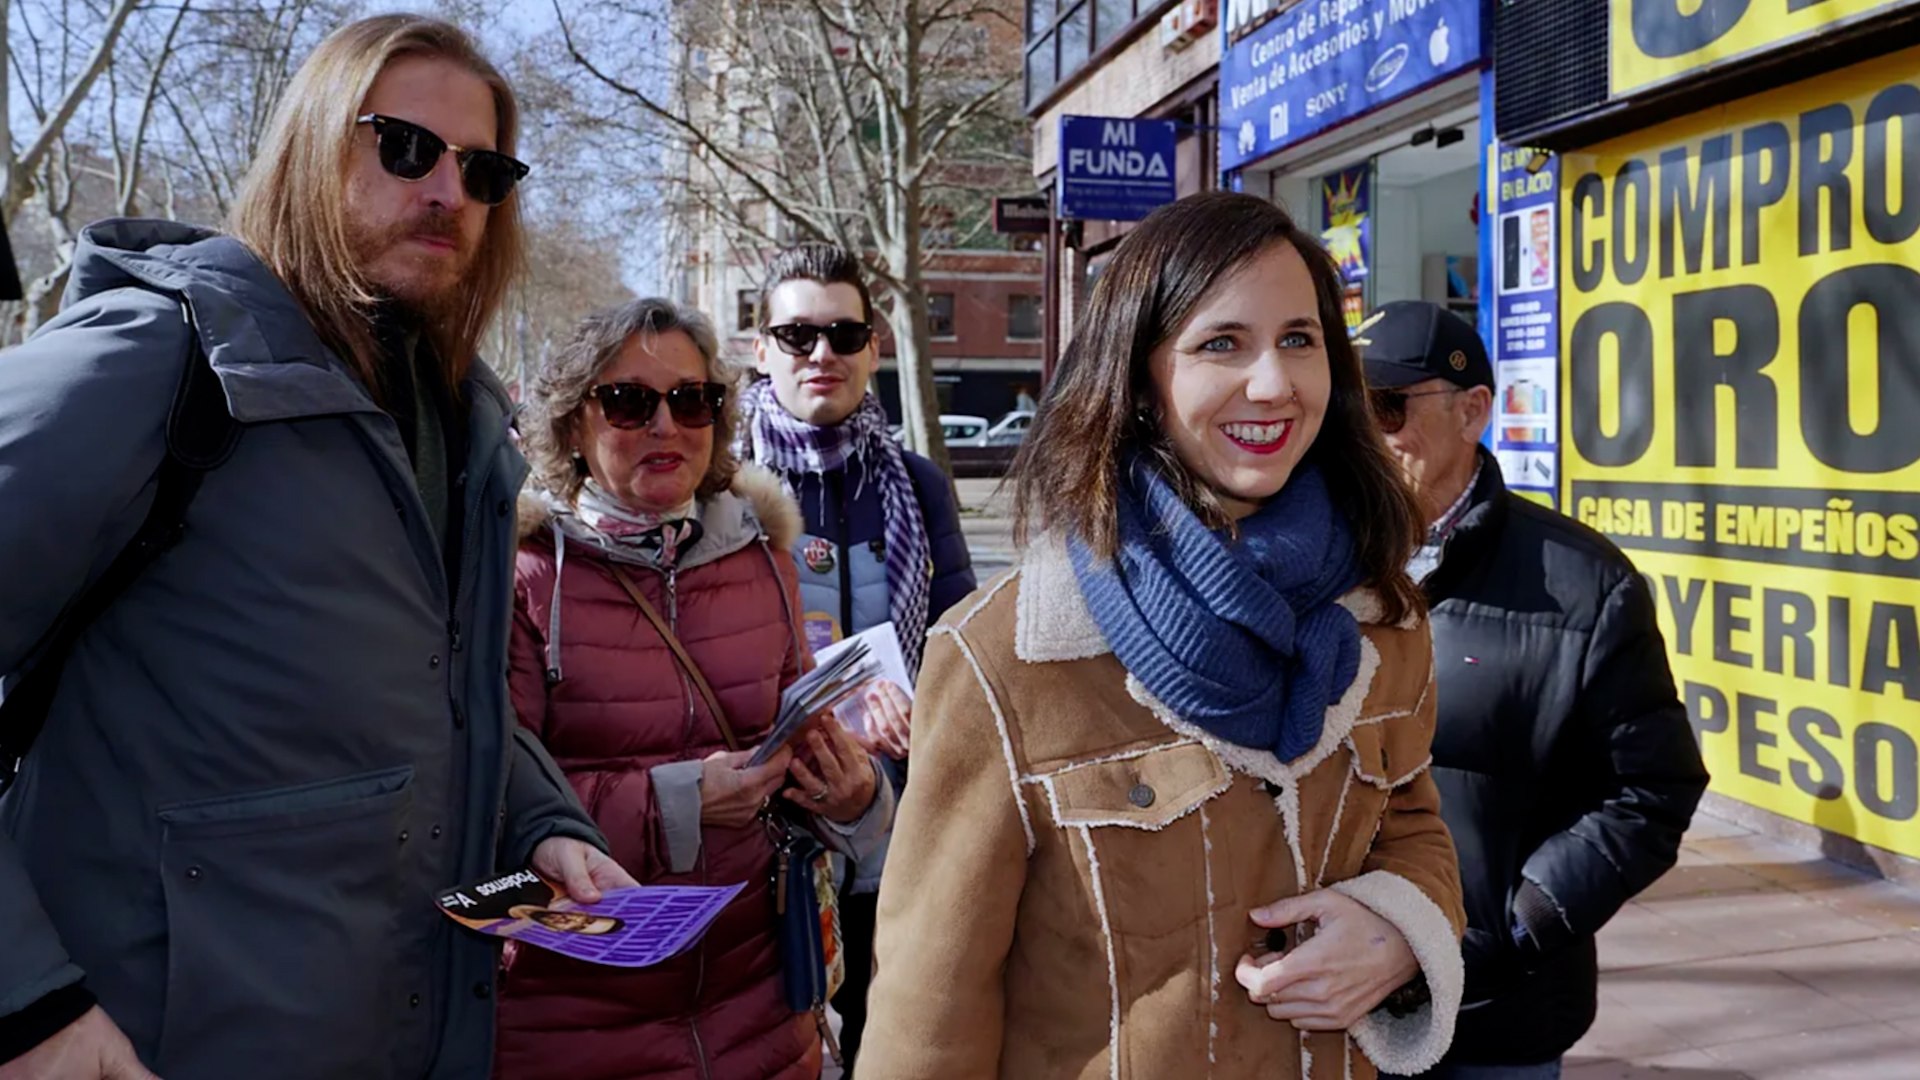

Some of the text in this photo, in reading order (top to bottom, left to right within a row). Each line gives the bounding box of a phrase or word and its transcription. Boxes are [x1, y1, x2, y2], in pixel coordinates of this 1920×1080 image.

[1231, 76, 1267, 109] Venta
[1269, 61, 1286, 89] de
[1288, 18, 1369, 79] Accesorios
[1374, 9, 1384, 41] y
[1251, 27, 1295, 68] Centro
[1297, 12, 1317, 40] de
[1306, 82, 1348, 117] SONY
[1069, 149, 1168, 177] FUNDA
[1102, 121, 1136, 146] MI
[1572, 83, 1920, 292] COMPRO
[1571, 262, 1920, 473] ORO
[1578, 497, 1919, 560] CASA DE EMPEÑOS
[1640, 571, 1920, 702] YERIA
[1683, 679, 1919, 821] PESO
[475, 869, 539, 896] Podemos
